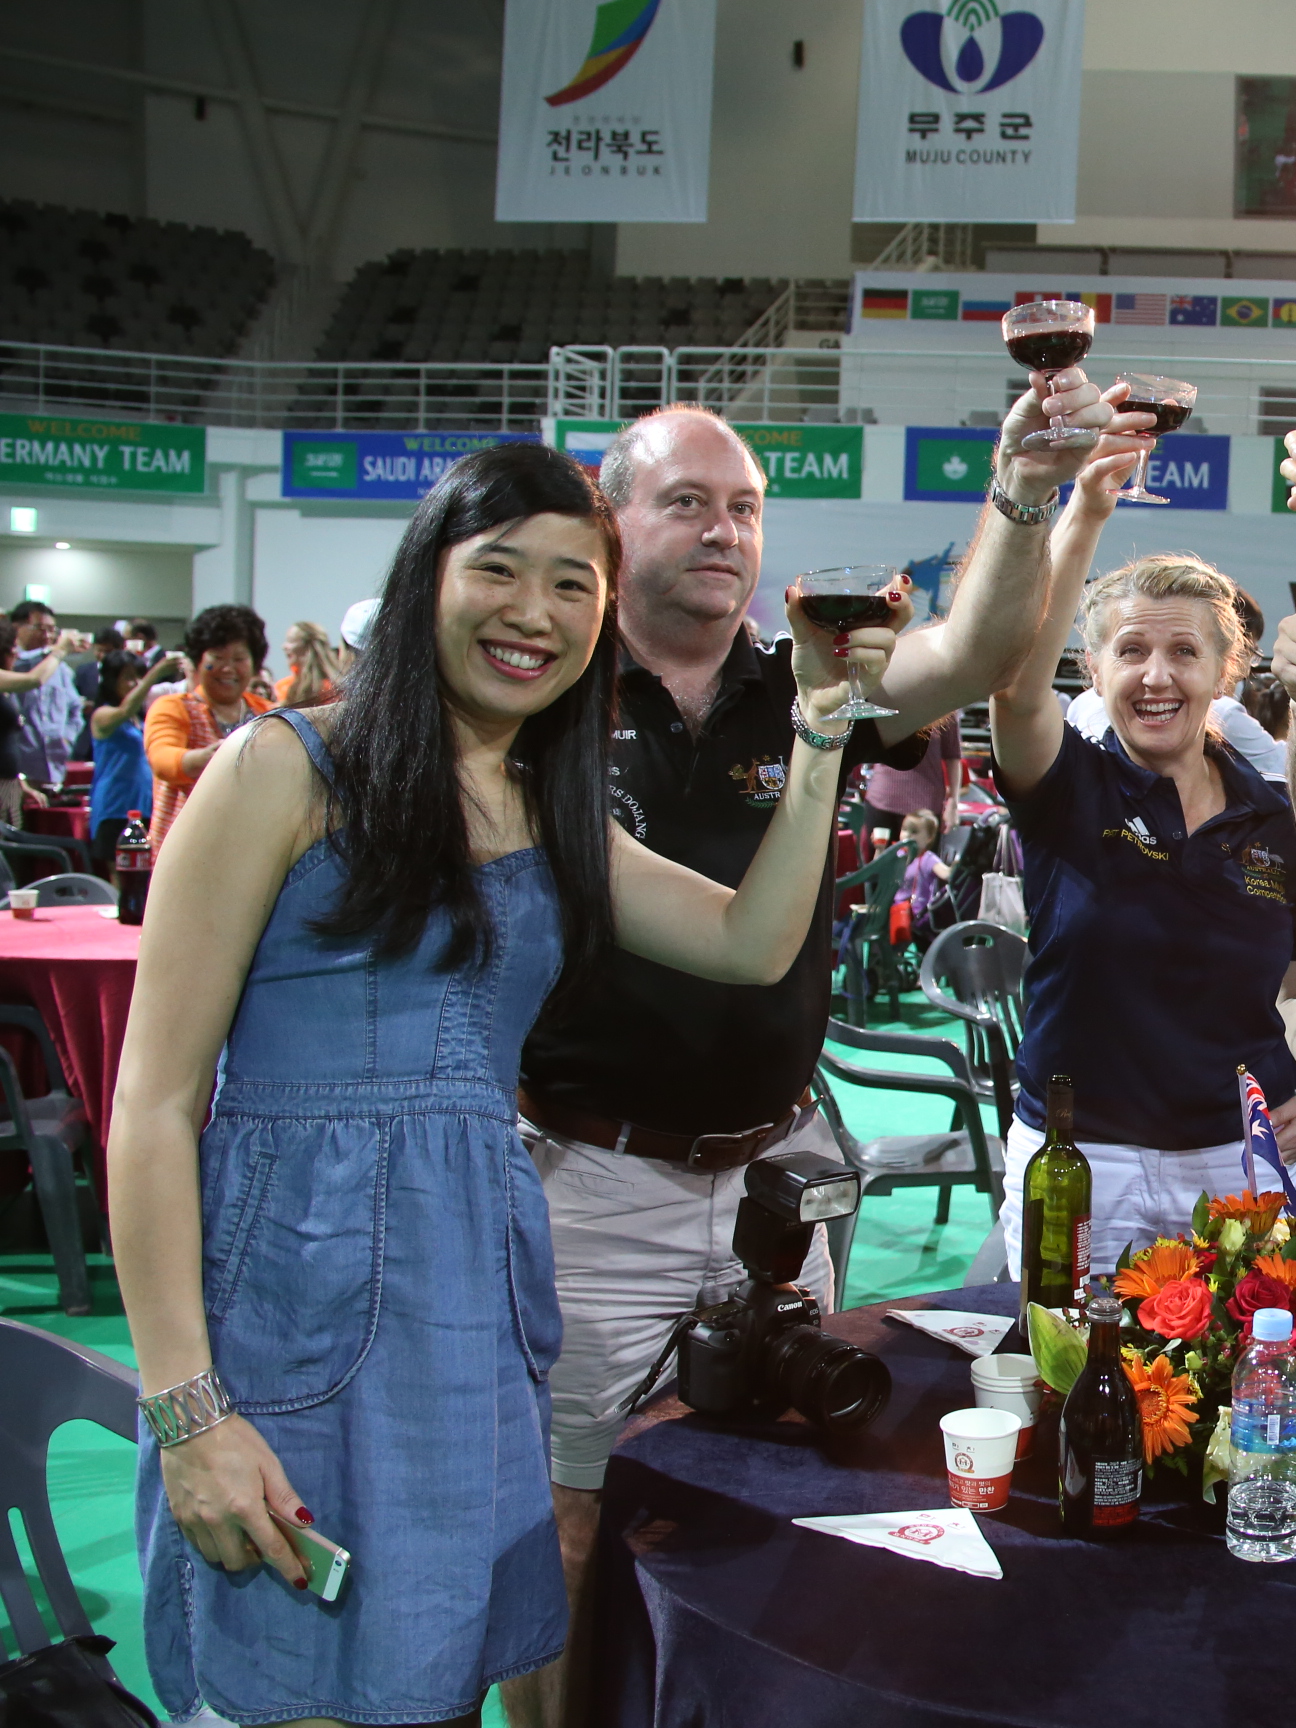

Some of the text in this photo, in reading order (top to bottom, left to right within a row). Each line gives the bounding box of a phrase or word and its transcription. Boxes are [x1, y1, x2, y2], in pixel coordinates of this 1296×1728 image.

[907, 111, 1032, 141] 무주군
[546, 128, 664, 162] 전라북도
[905, 148, 1032, 165] MUJU COUNTY
[27, 419, 143, 442] WELCOME
[743, 430, 804, 447] COME
[119, 445, 193, 475] TEAM
[363, 455, 417, 483] SAUDI
[764, 451, 850, 481] TEAM
[777, 1300, 803, 1312] Canon
